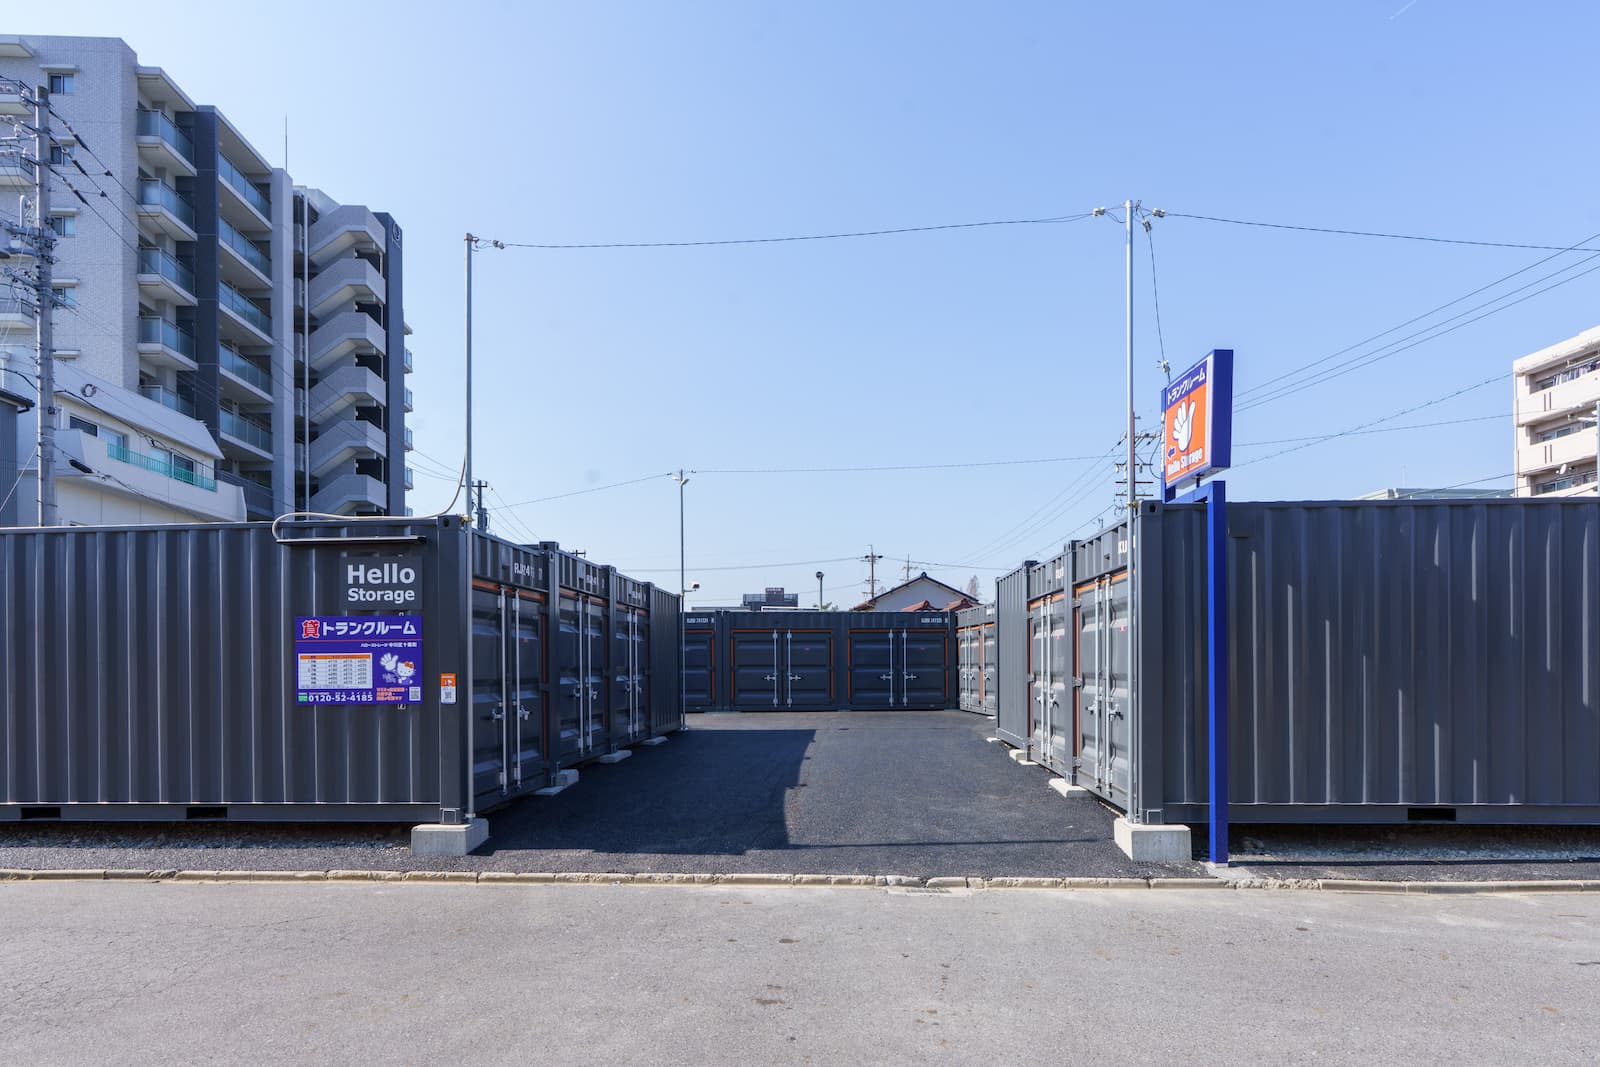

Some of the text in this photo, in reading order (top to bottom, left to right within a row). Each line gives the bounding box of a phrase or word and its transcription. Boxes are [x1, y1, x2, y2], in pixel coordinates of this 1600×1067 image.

[1167, 368, 1206, 405] トランクルーム
[347, 563, 416, 585] Hello
[347, 588, 415, 604] Storage
[308, 694, 373, 702] 0120-52-4185
